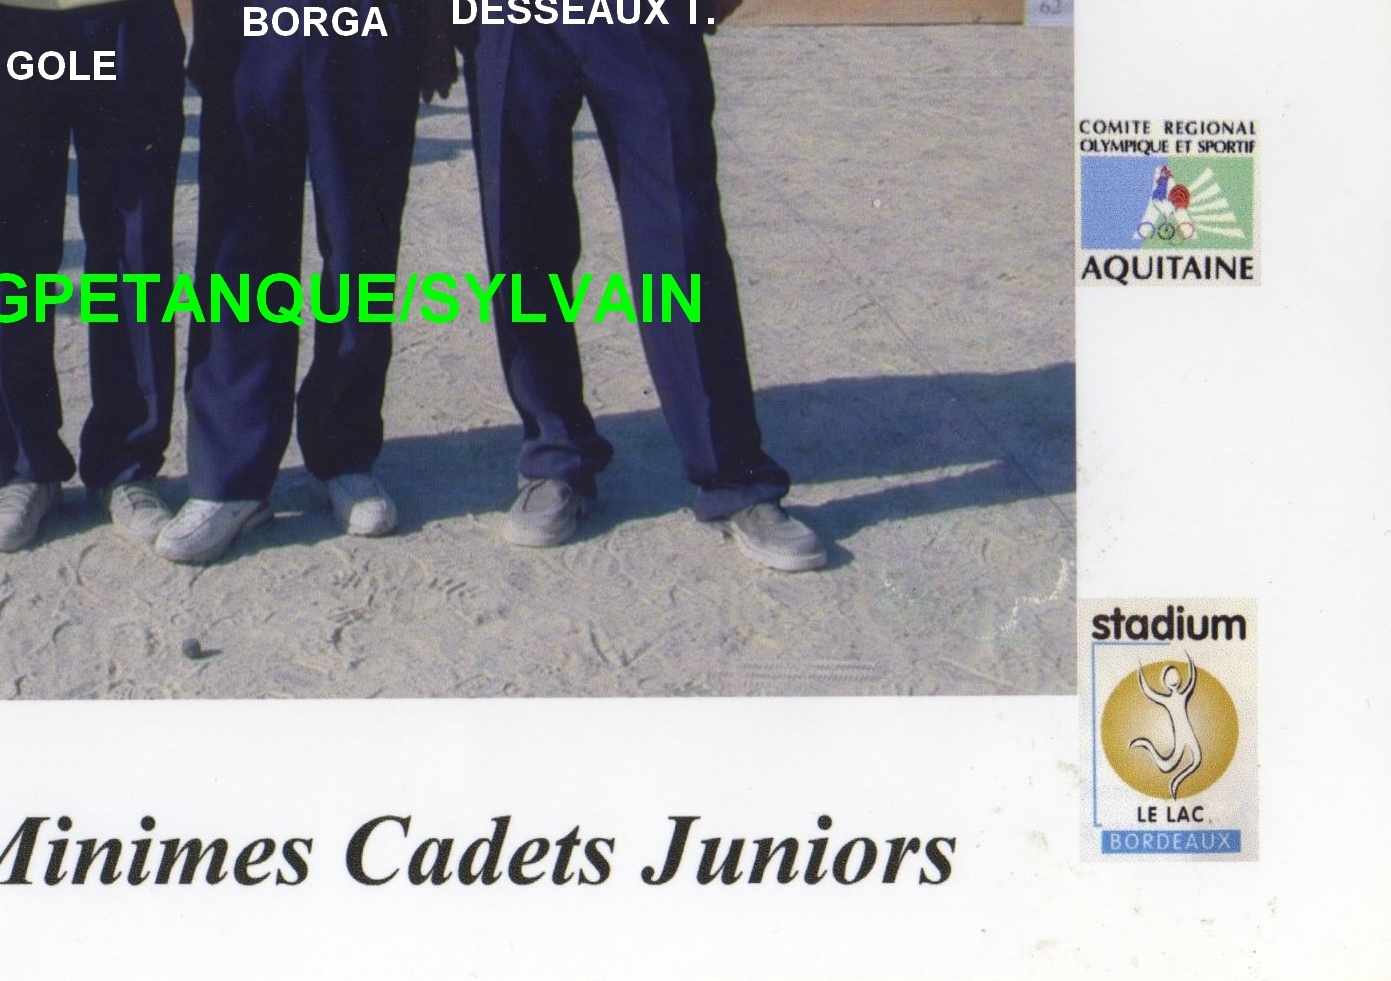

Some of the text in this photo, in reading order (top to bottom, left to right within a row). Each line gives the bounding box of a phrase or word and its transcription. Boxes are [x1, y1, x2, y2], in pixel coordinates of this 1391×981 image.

[1079, 120, 1256, 135] COMITE REGIONAL
[1080, 140, 1255, 155] OLYMPIQUE ET SPORTIF
[1081, 255, 1254, 285] AQUITAINE
[1092, 605, 1246, 641] stadium
[1137, 806, 1204, 822] LE LAC
[1110, 833, 1231, 850] BORDEAUX
[345, 813, 616, 888] Cadets
[641, 813, 959, 888] Juniors
